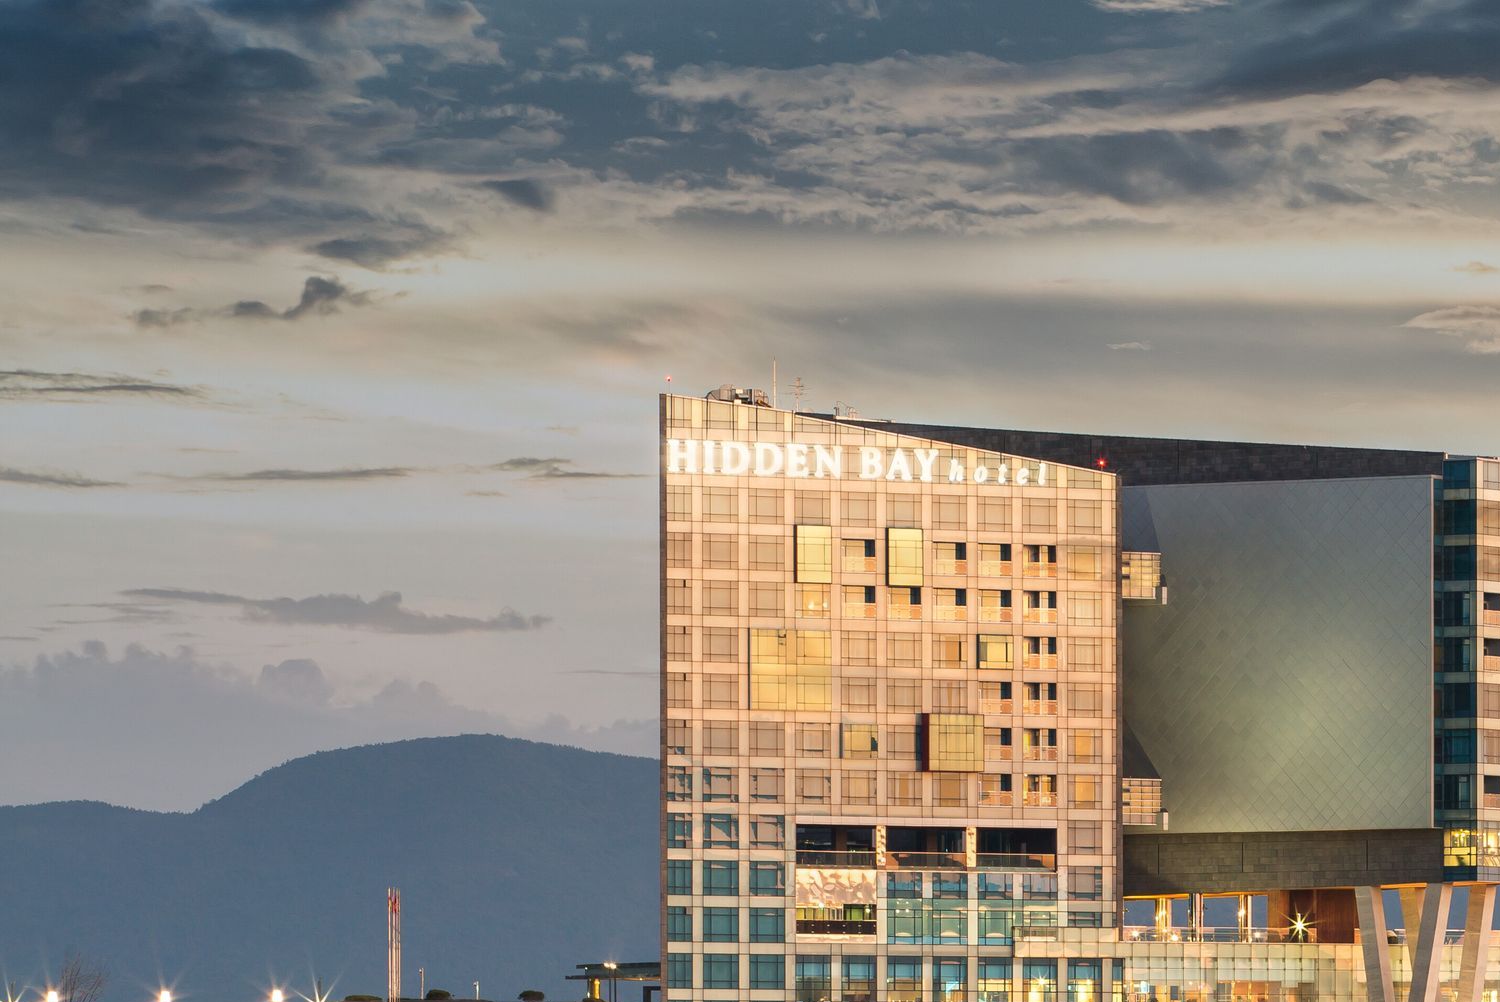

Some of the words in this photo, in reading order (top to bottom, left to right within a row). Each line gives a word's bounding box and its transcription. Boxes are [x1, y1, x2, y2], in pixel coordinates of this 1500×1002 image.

[667, 438, 843, 479] HIDDEN
[858, 446, 940, 482] BAY
[949, 457, 1047, 486] hotel
